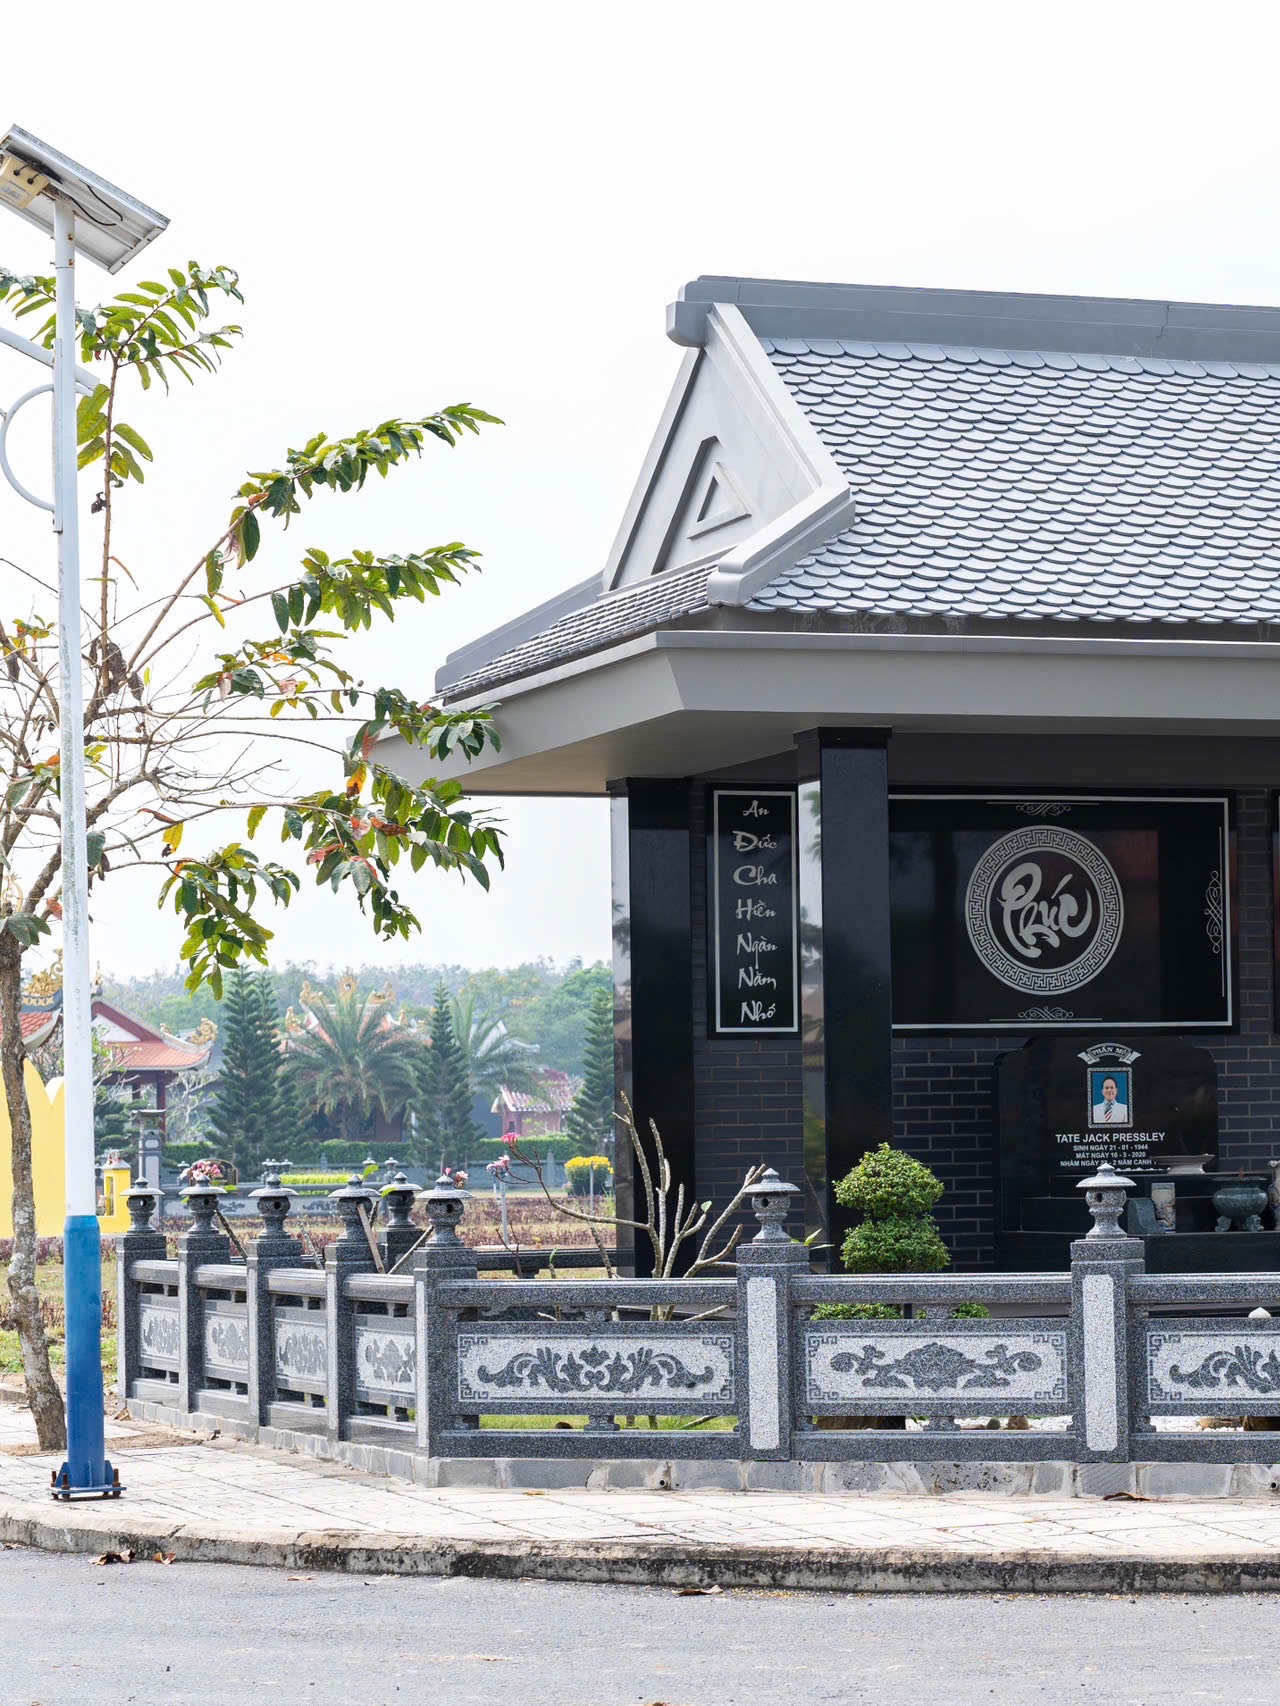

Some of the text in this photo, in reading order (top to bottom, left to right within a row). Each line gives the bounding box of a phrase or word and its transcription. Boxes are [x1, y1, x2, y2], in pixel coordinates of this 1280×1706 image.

[732, 830, 777, 851] Đức
[733, 865, 777, 886] Cha
[736, 898, 777, 920] Hiền
[996, 862, 1093, 958] Phúc
[736, 932, 778, 969] Ngàn
[738, 966, 777, 989] Năm
[740, 1000, 776, 1023] Nhớ
[1055, 1132, 1165, 1143] TATE JACK PRESSLEY
[1089, 1143, 1108, 1151] NGÀY
